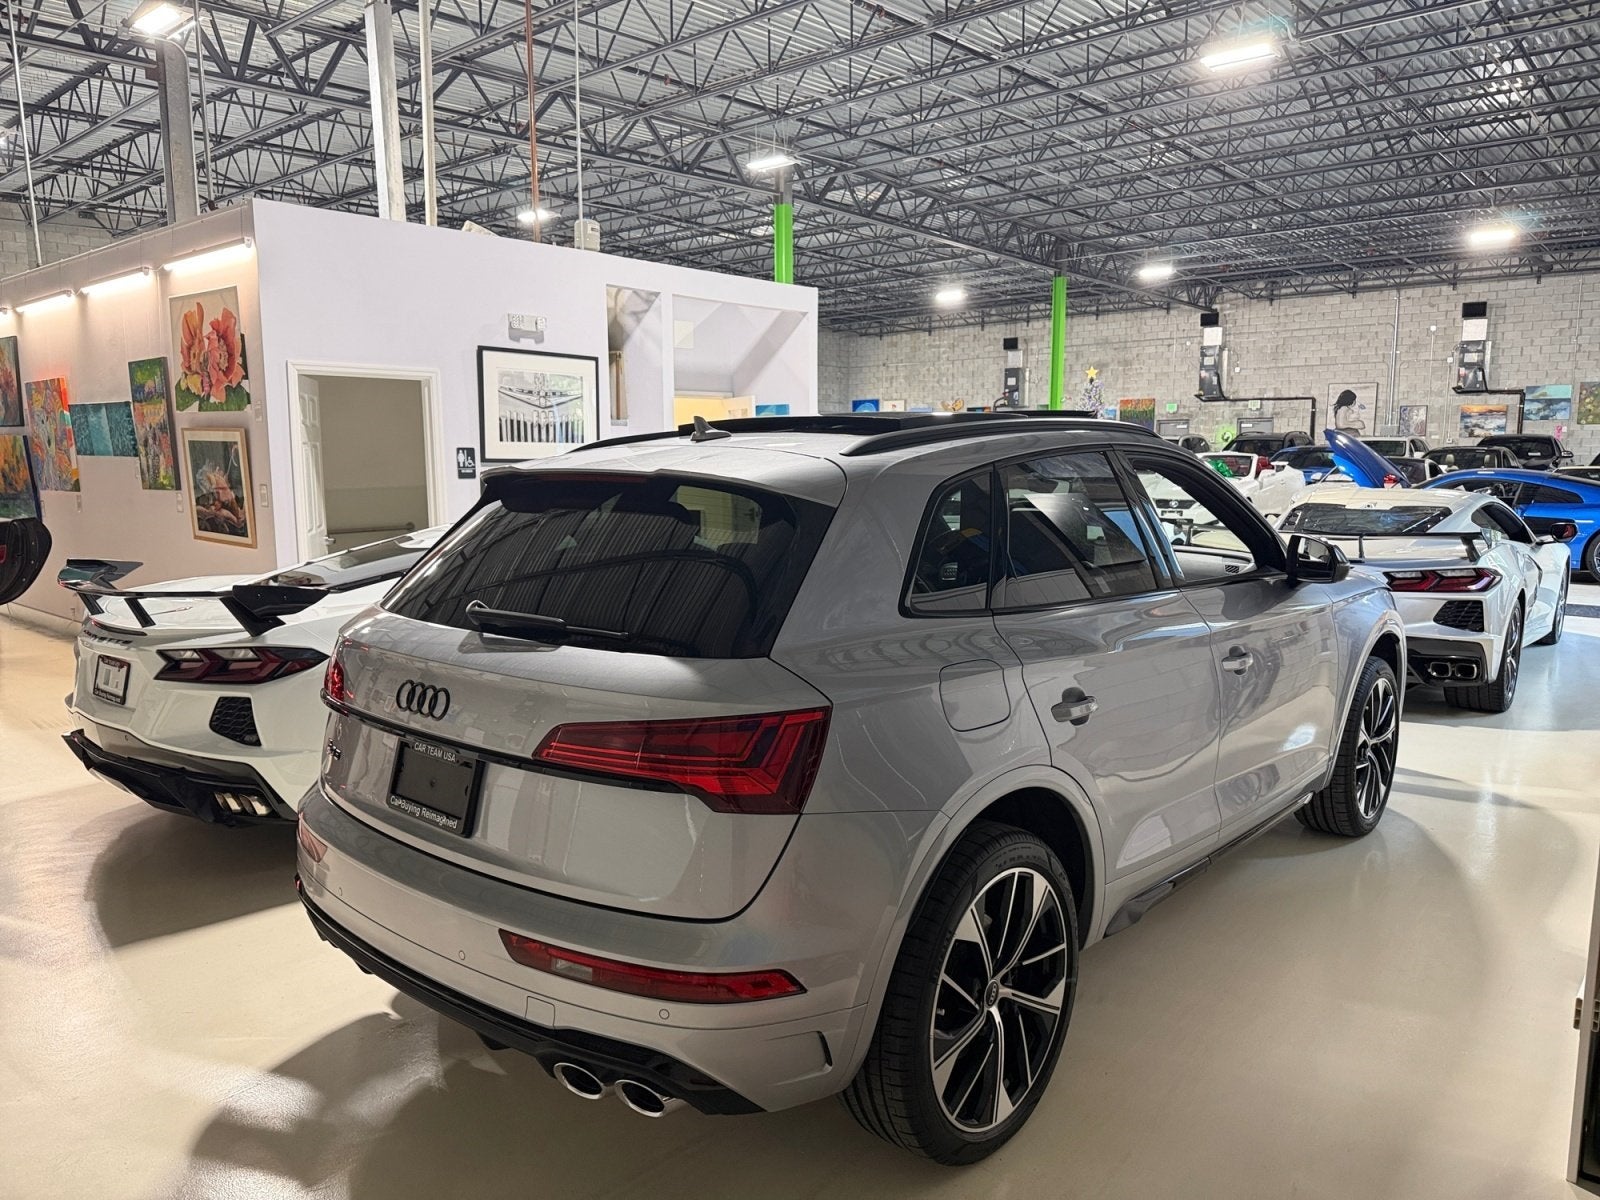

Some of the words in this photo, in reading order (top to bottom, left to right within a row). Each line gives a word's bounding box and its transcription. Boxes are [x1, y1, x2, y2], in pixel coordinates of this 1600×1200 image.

[414, 742, 427, 753] CAR
[427, 745, 443, 758] TEAM
[443, 752, 456, 762] USA
[421, 807, 458, 829] Reimagined
